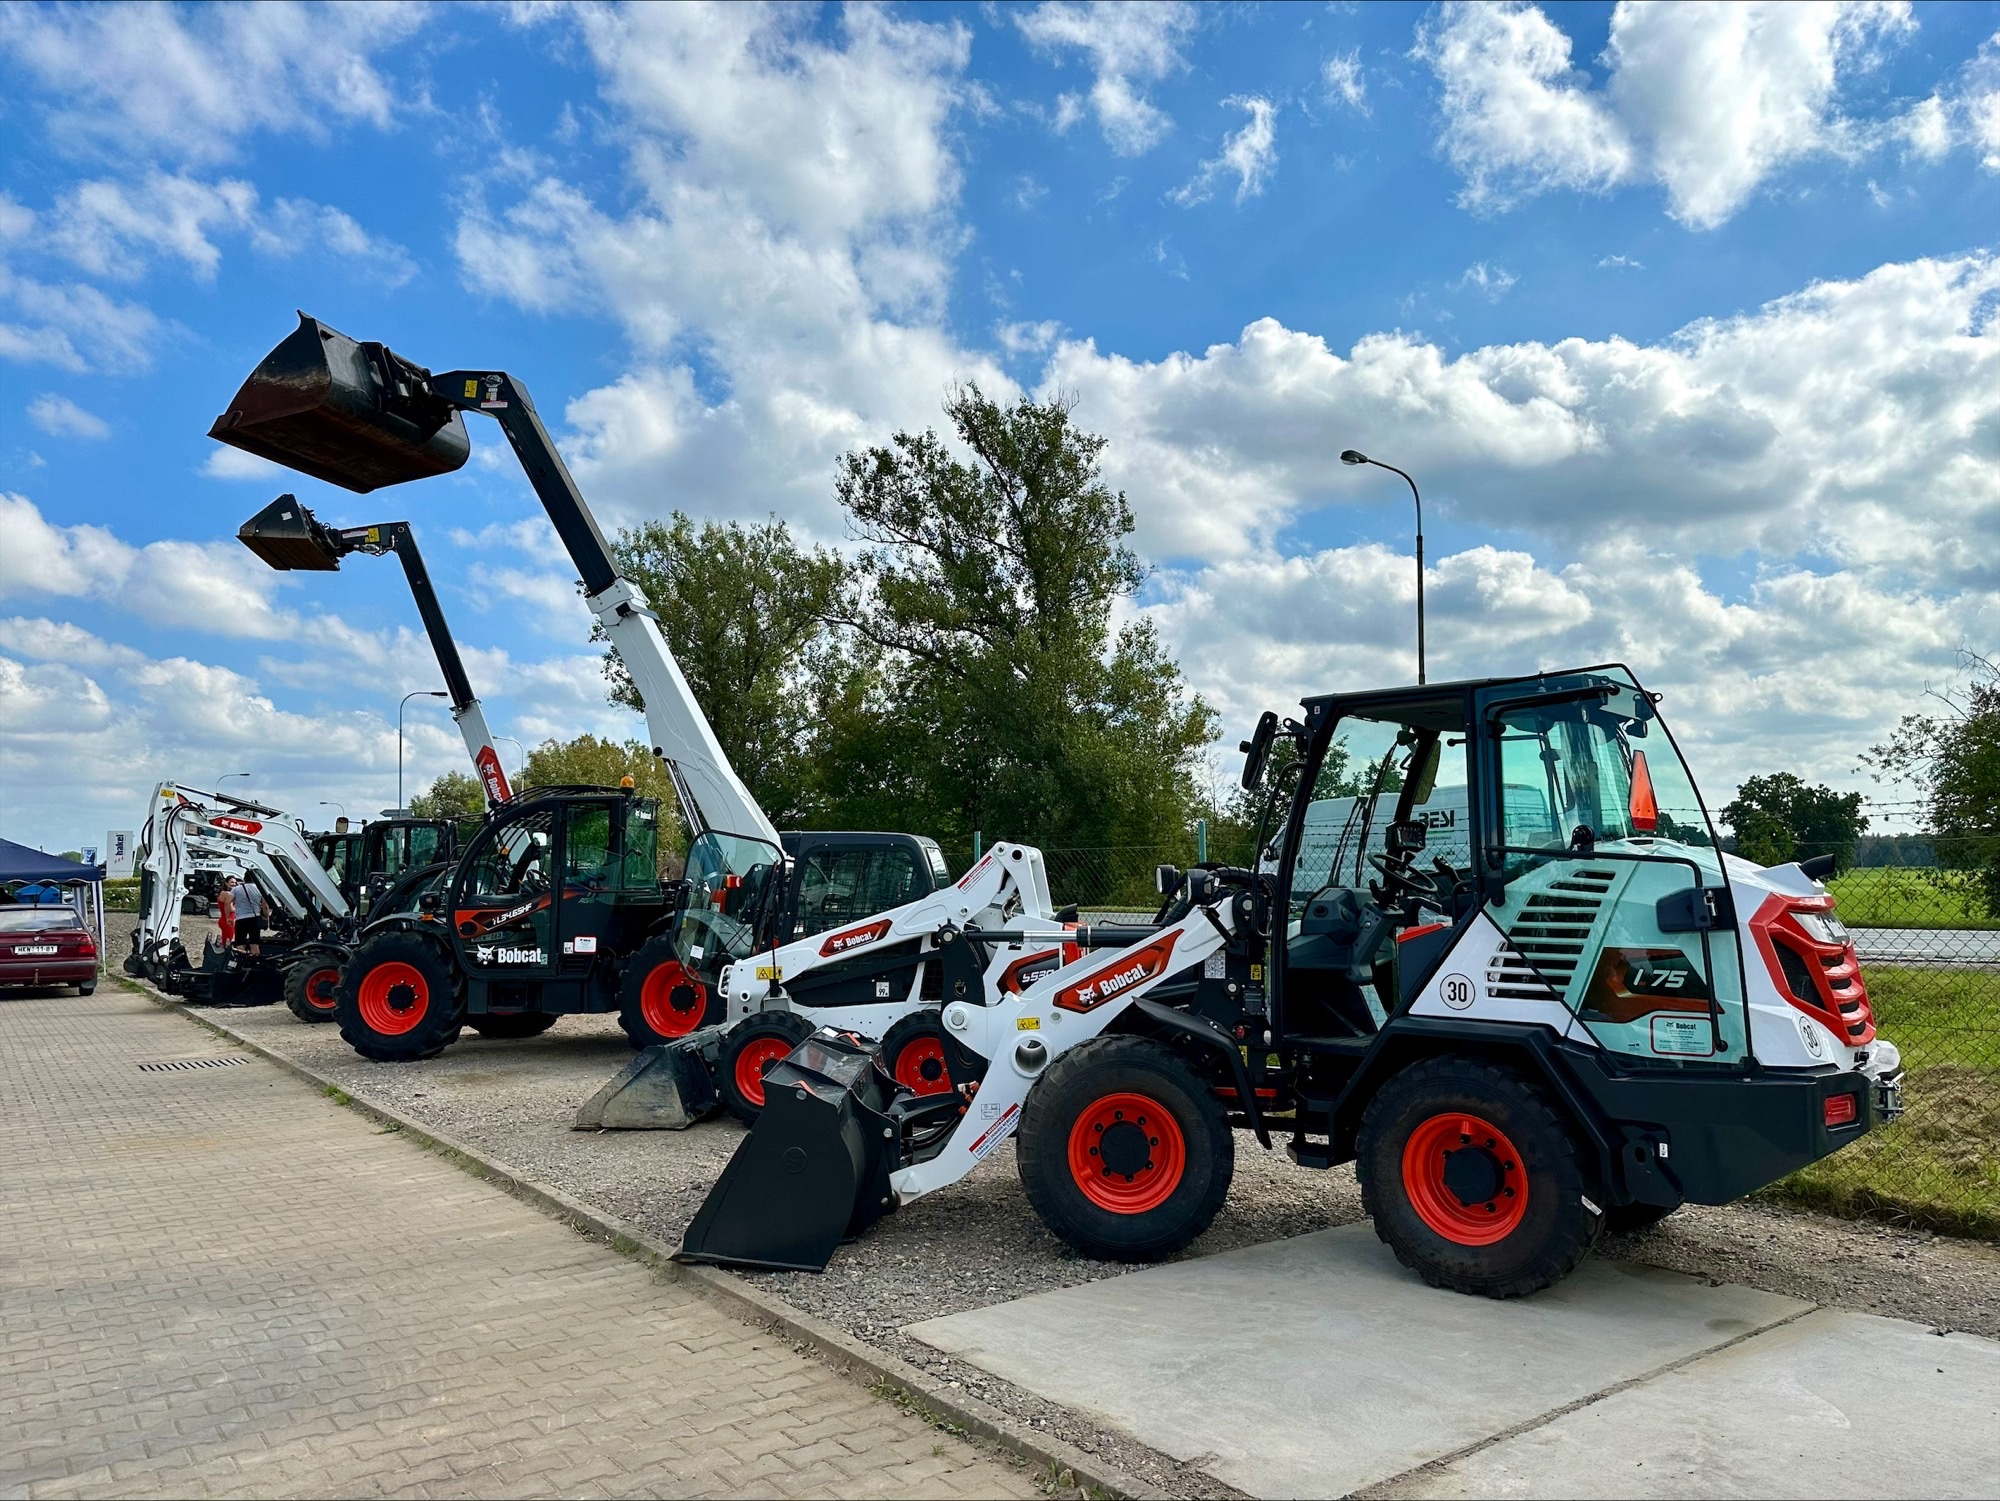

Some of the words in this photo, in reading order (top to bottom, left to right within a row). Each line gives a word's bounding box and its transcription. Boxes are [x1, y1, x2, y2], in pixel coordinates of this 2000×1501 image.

[487, 777, 504, 803] Bobca
[229, 822, 249, 832] Bobcat
[115, 834, 124, 856] hakel
[232, 846, 250, 855] Bobcat
[845, 931, 873, 947] Bobcat
[497, 947, 542, 964] Bobcat
[1098, 963, 1147, 996] Bobcat
[1447, 981, 1468, 1003] 30
[1675, 1022, 1697, 1030] Bobcat
[1803, 1025, 1819, 1049] 30
